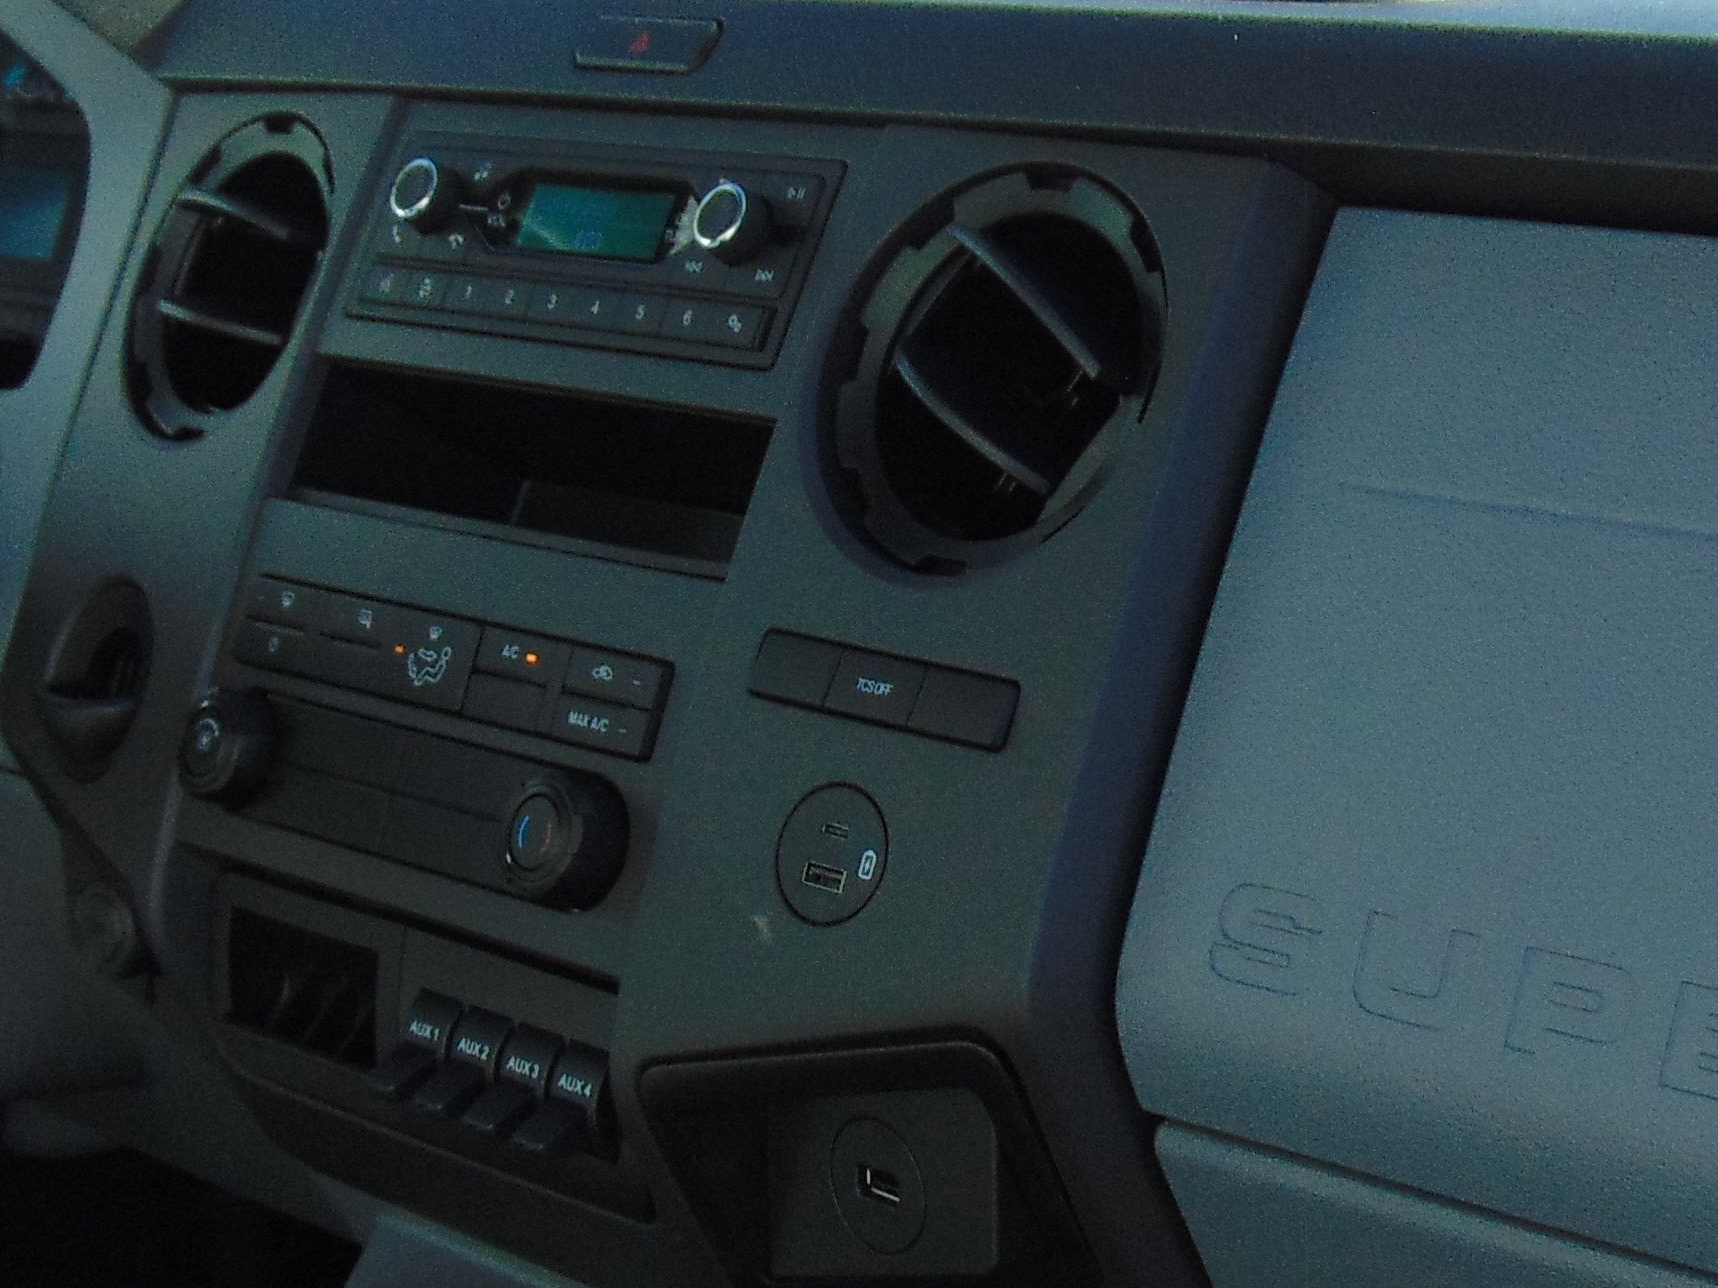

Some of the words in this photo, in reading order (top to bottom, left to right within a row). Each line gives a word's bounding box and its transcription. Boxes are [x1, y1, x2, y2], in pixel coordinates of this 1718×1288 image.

[464, 284, 473, 300] 1
[503, 289, 514, 305] 2
[547, 293, 557, 311] 3
[590, 299, 601, 316] 4
[635, 304, 646, 321] 5
[682, 309, 693, 327] 6
[874, 681, 895, 697] OFF
[409, 1020, 434, 1039] AUX
[433, 1028, 440, 1041] 1
[457, 1037, 481, 1058] AUX
[480, 1045, 491, 1060] 2
[505, 1056, 531, 1076] AUX
[530, 1063, 540, 1079] 3
[557, 1074, 584, 1094] AUX
[583, 1082, 593, 1098] 4
